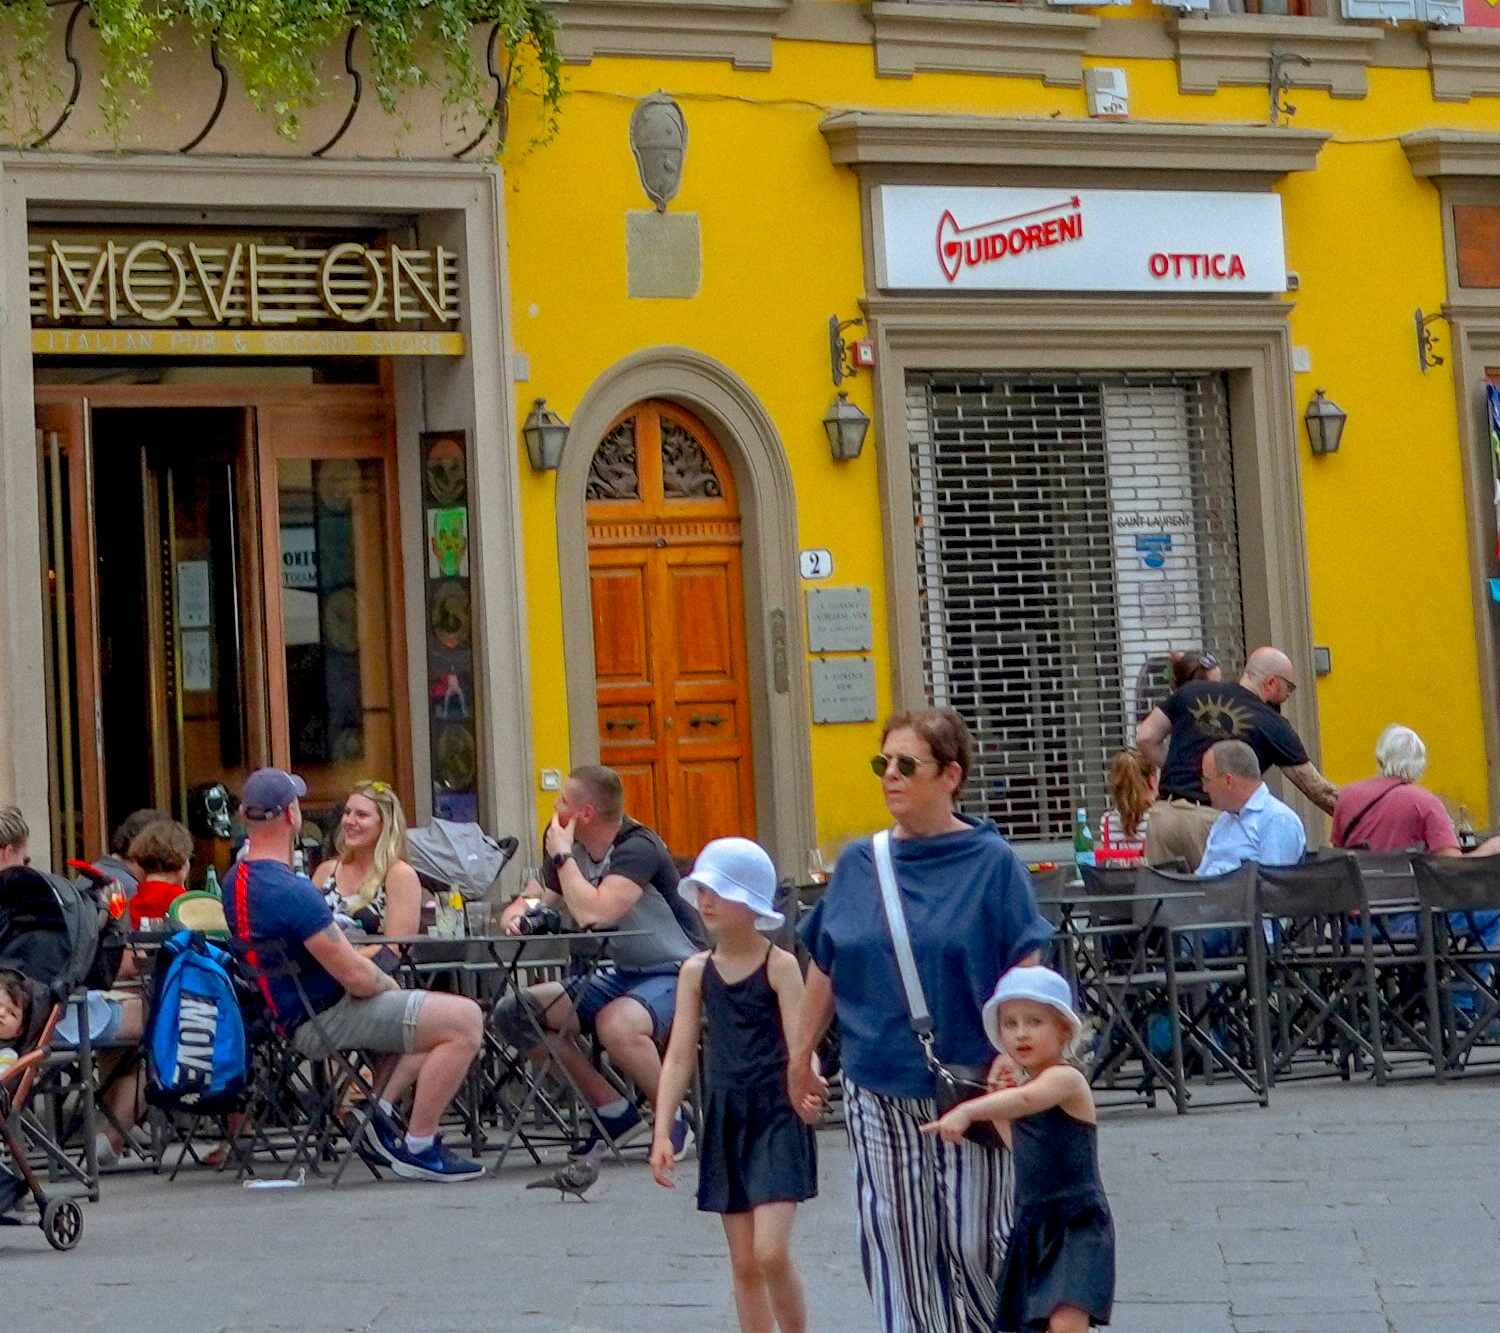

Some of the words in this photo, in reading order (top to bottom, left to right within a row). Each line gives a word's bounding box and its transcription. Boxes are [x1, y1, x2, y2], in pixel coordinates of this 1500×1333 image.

[1148, 252, 1246, 279] OTTICA
[47, 238, 298, 323] MOVE
[320, 242, 448, 324] ON
[47, 332, 153, 351] ITALIAN
[171, 332, 217, 351] PUB
[264, 332, 354, 352] RECORD
[369, 332, 444, 354] STORE
[1116, 515, 1144, 529] SAINT
[809, 551, 821, 575] 2
